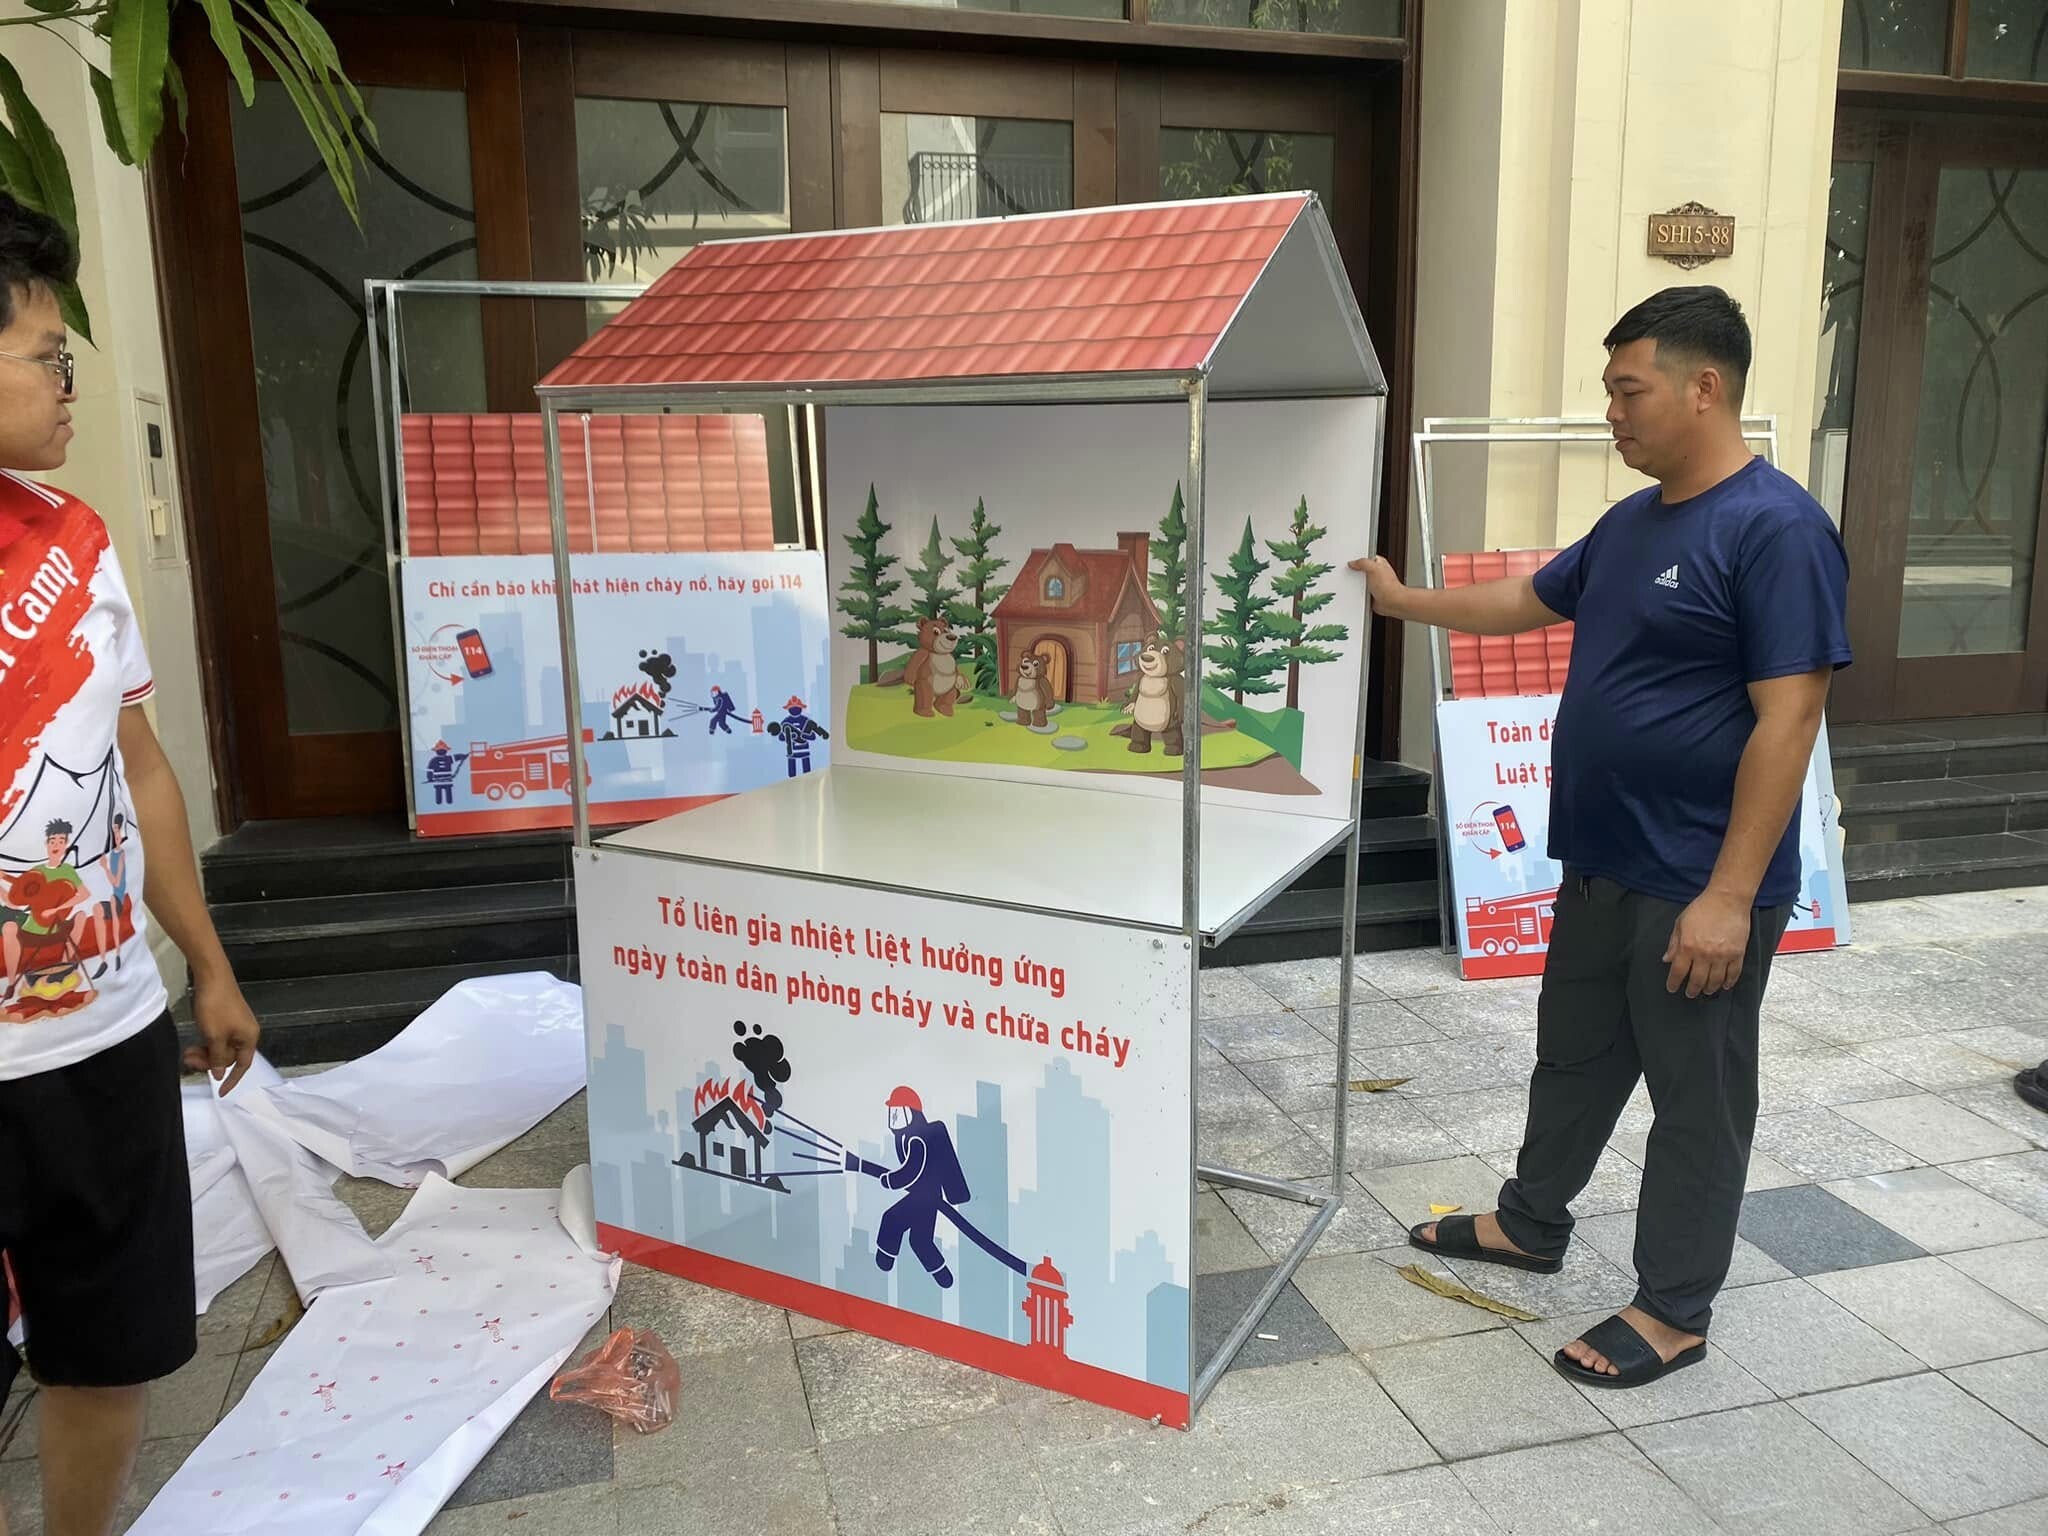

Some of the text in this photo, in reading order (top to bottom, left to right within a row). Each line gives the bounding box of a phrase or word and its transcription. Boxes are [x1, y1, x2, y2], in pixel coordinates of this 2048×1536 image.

[1657, 223, 1730, 245] SH15-88
[0, 546, 79, 640] Camp
[461, 579, 490, 597] cần
[572, 578, 600, 594] hát
[605, 577, 640, 596] hiện
[646, 576, 683, 595] cháy
[718, 575, 746, 593] hãy
[752, 576, 774, 593] gọi
[779, 574, 802, 589] 114
[1654, 576, 1679, 589] adidas
[464, 646, 482, 655] 114
[1487, 721, 1532, 743] Toàn
[1495, 762, 1538, 788] Luật
[1500, 822, 1516, 830] 114
[658, 896, 1065, 998] Tổ liên gia nhiệt liệt hưởng ứng
[613, 944, 1131, 1068] ngày toàn dân phòng cháy và chữa cháy
